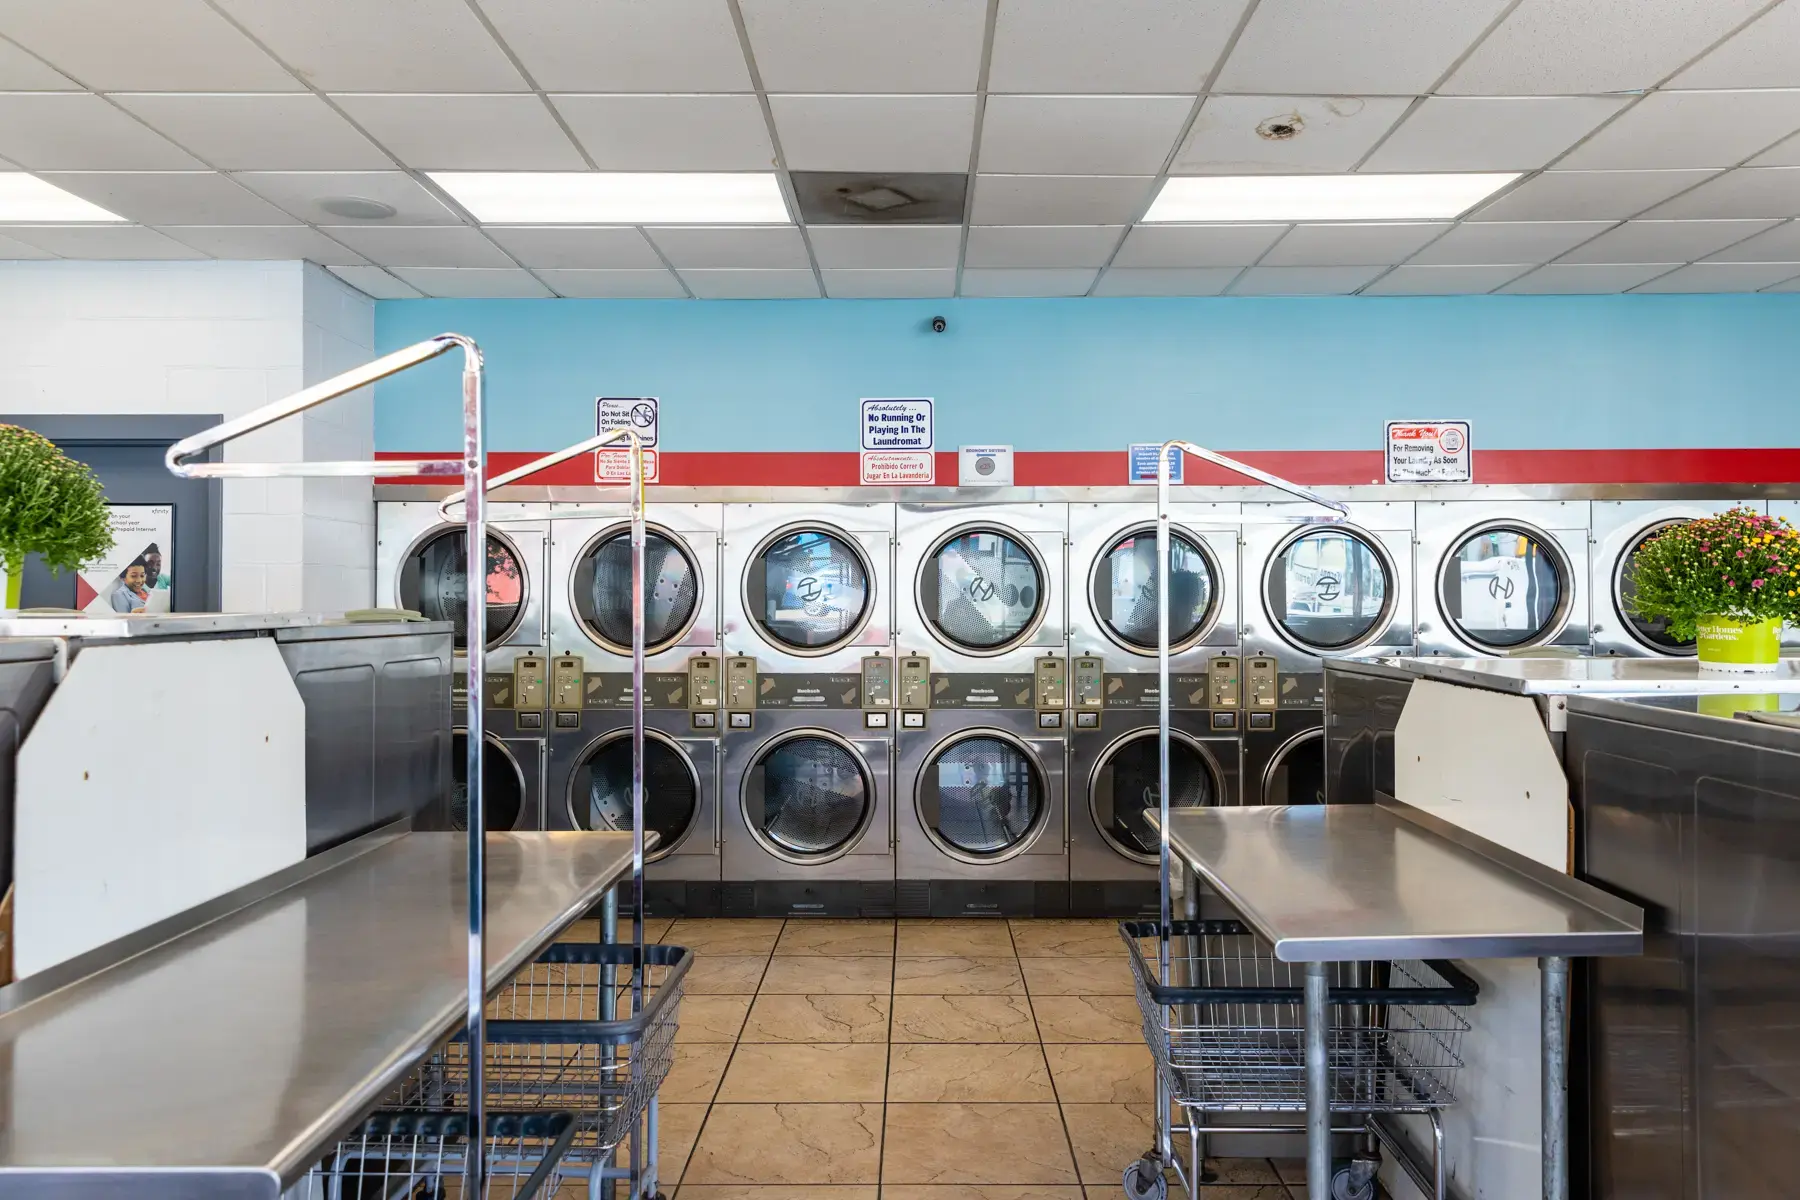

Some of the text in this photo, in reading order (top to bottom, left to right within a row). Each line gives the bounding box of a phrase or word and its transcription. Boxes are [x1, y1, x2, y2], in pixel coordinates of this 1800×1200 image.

[866, 403, 908, 412] Absolutely
[611, 418, 631, 426] Folding
[868, 413, 926, 423] No Running Or
[869, 425, 926, 435] Playing In The
[1392, 428, 1437, 438] Thank You!
[873, 437, 922, 446] Laundromat
[1393, 444, 1434, 453] For Removing
[1393, 456, 1407, 464] Your
[1433, 456, 1442, 464] As
[1443, 456, 1458, 464] Soon
[1712, 625, 1743, 634] Homes
